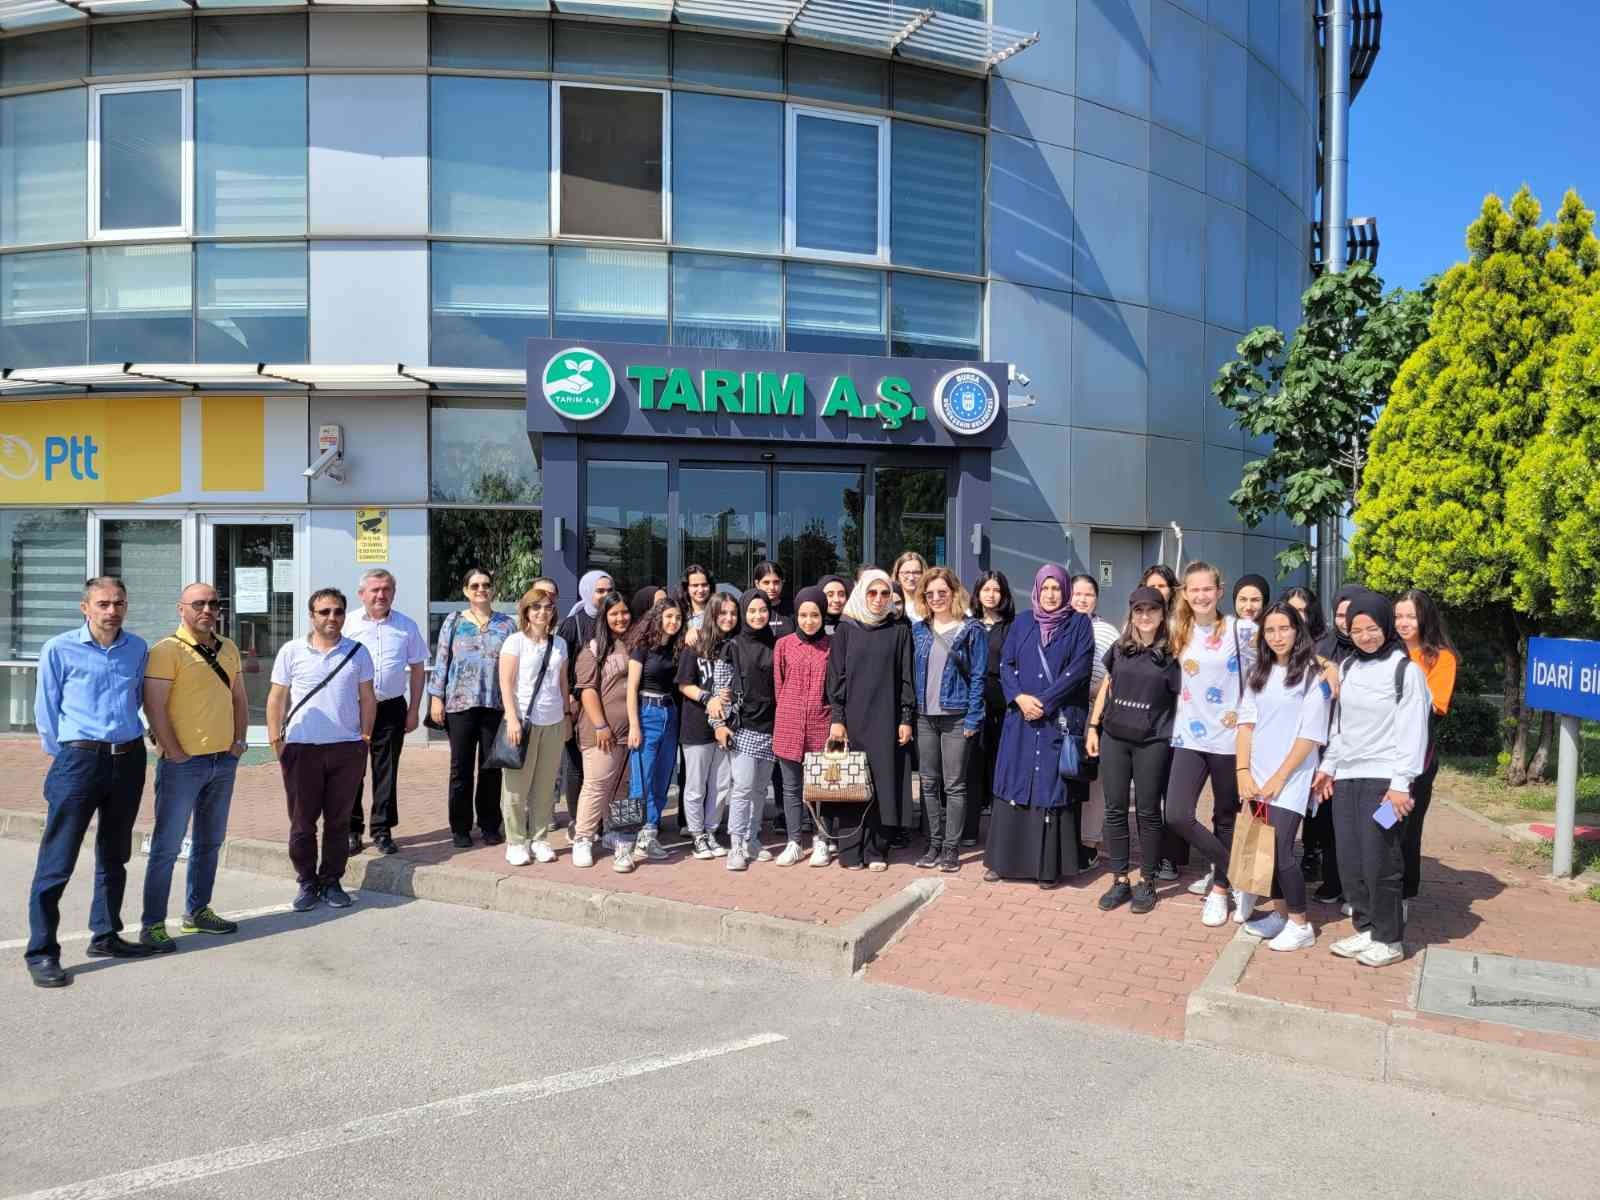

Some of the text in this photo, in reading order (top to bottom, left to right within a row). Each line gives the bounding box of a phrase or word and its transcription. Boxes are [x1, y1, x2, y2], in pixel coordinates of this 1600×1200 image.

[626, 365, 927, 429] TARIM A.Ş.
[45, 435, 99, 480] Ptt
[1532, 657, 1600, 696] İDARİ Bİ
